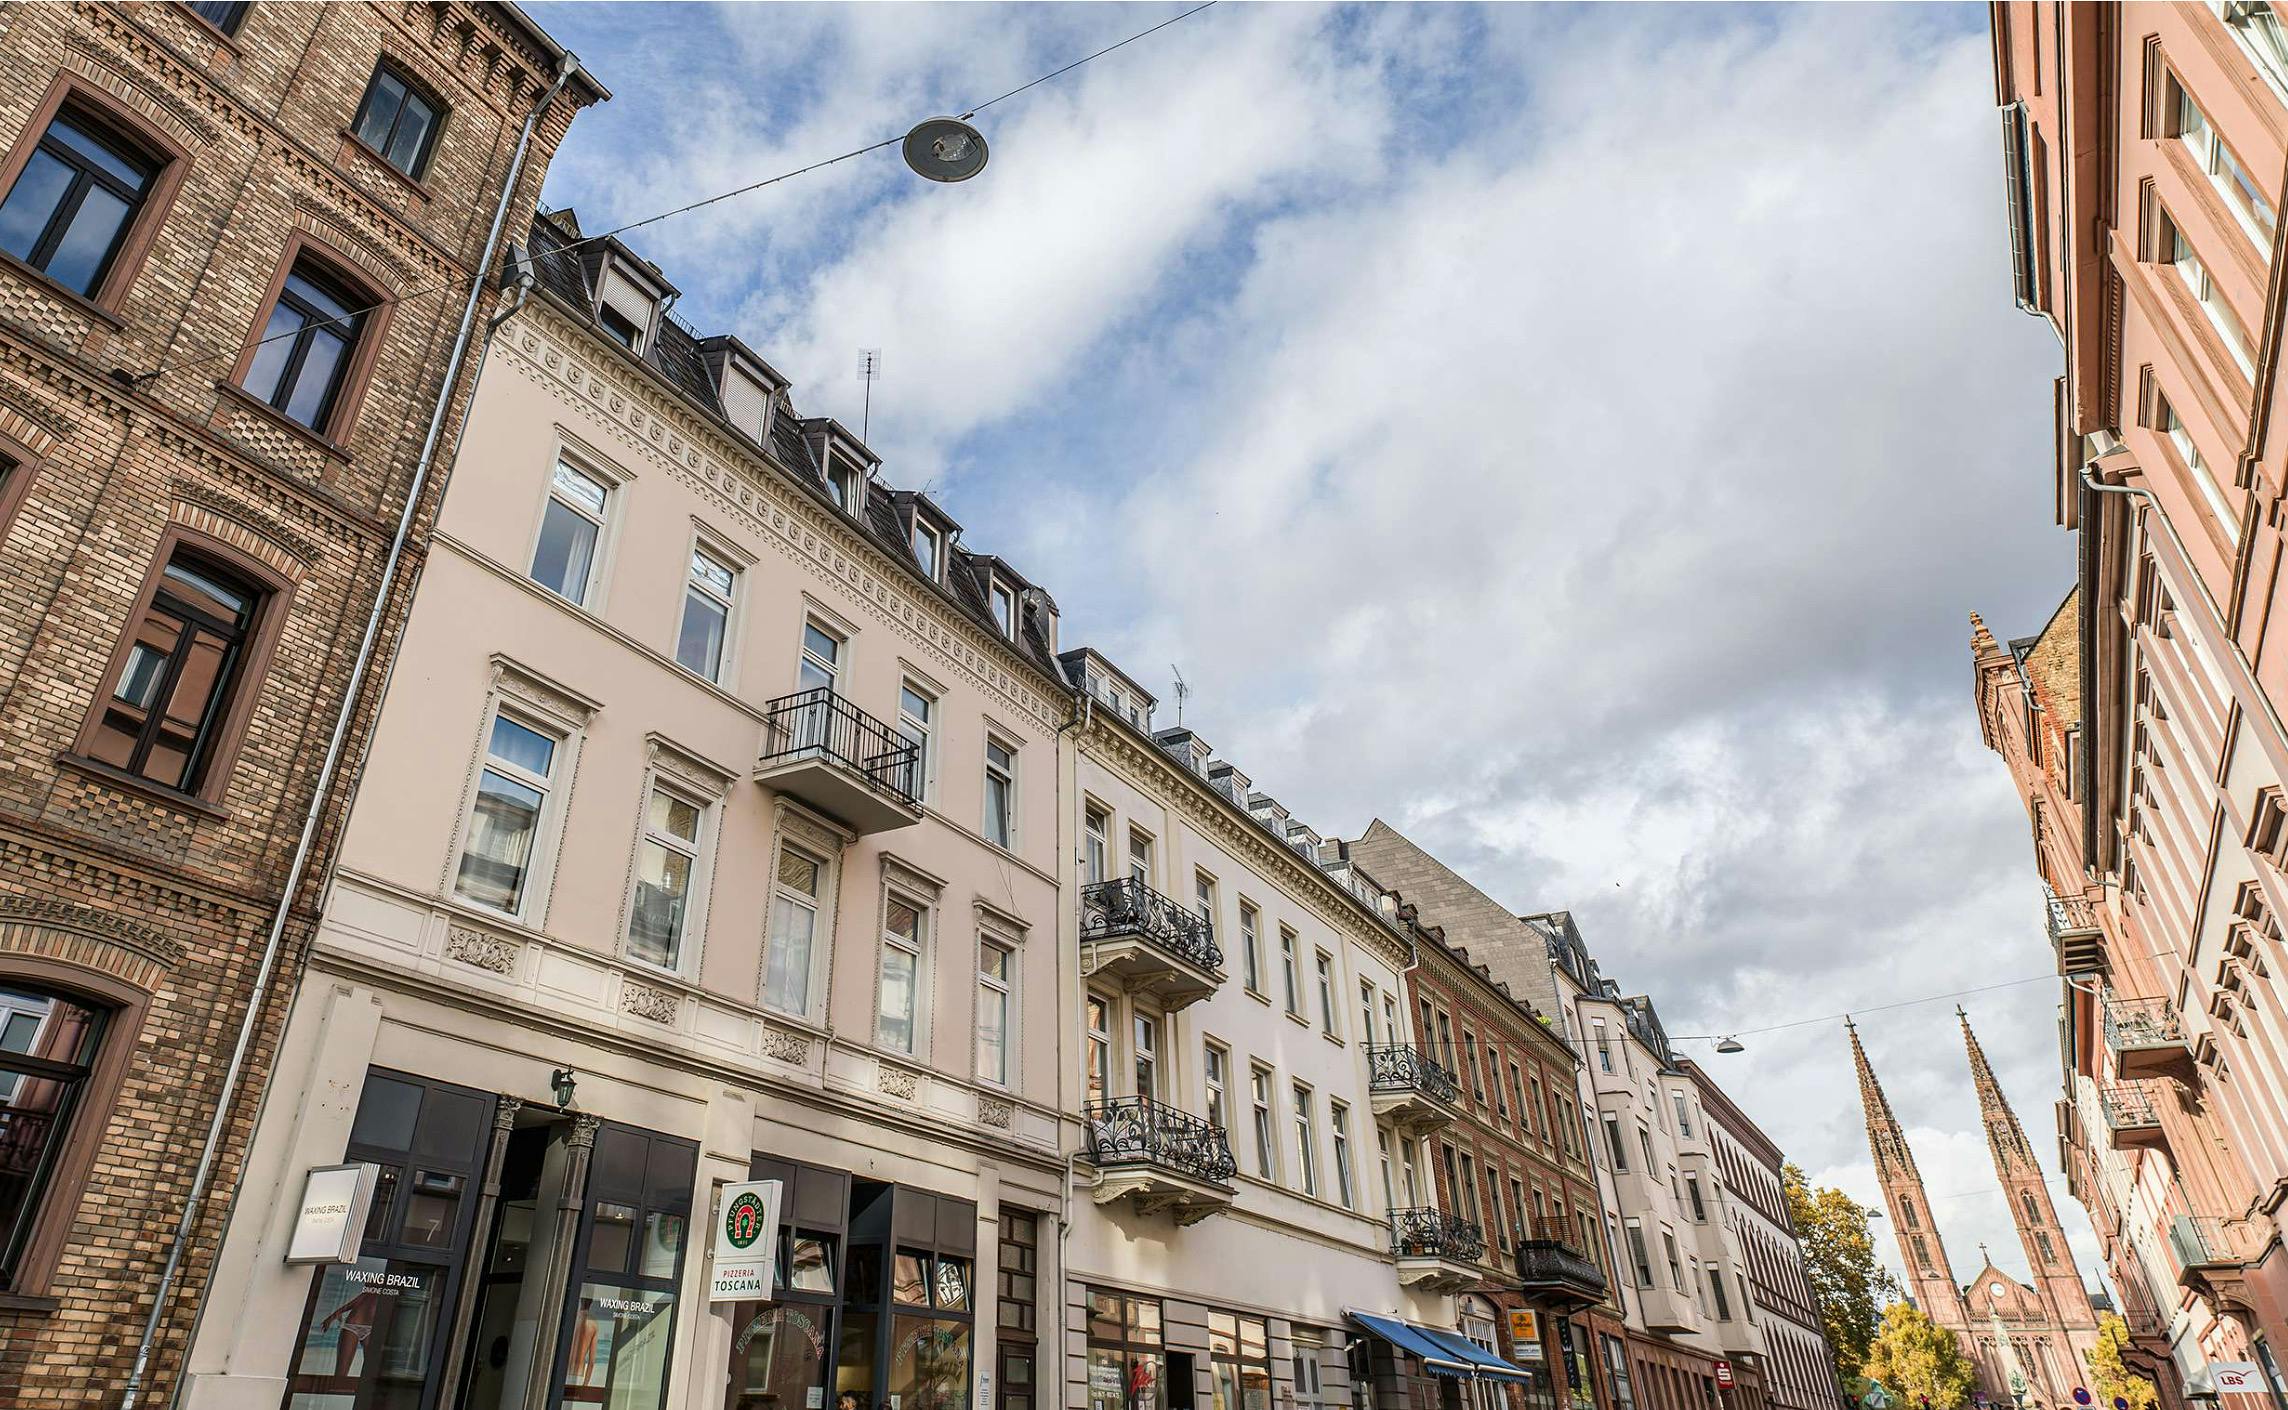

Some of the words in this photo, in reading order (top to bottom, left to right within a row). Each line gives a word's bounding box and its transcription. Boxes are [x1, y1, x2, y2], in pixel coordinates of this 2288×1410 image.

[723, 1269, 755, 1277] PIZZERIA
[345, 1269, 386, 1285] WAXING
[386, 1274, 420, 1289] BRAZIL
[714, 1279, 761, 1291] TOSCANA
[361, 1286, 382, 1294] SIMONE
[382, 1287, 400, 1296] COSTA
[600, 1297, 629, 1311] WAXING
[630, 1301, 655, 1314] BRAZIL
[2221, 1376, 2244, 1385] LBS
